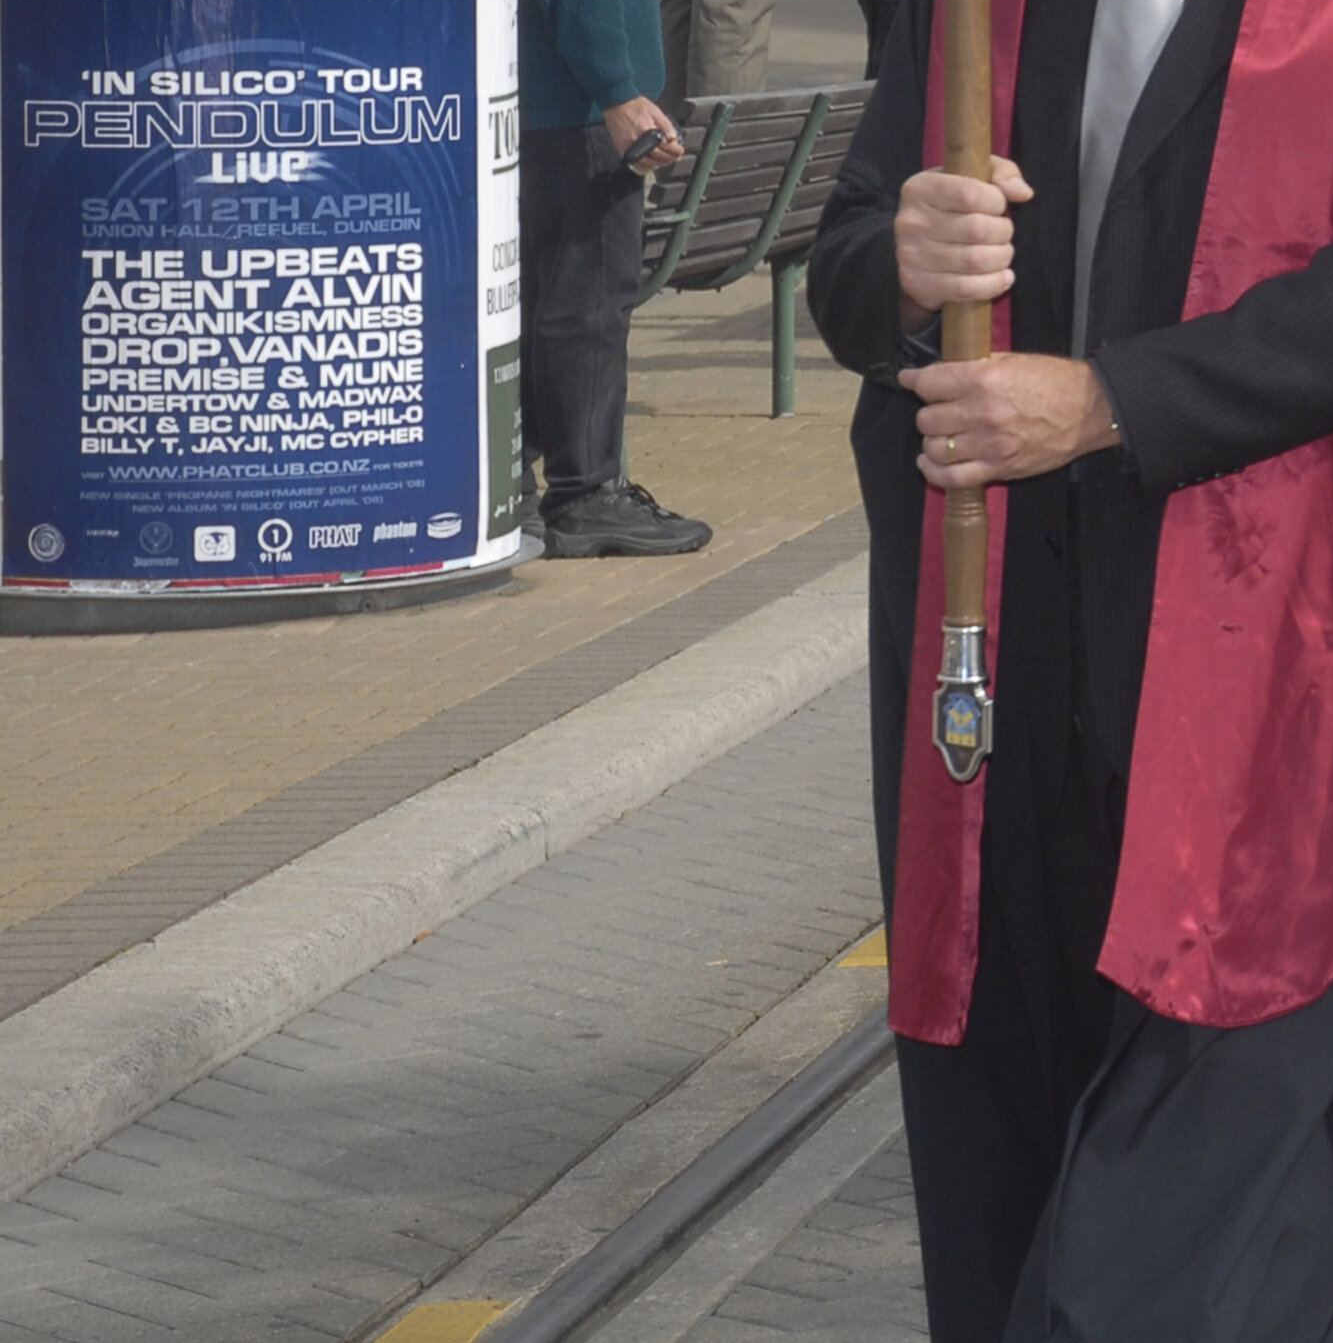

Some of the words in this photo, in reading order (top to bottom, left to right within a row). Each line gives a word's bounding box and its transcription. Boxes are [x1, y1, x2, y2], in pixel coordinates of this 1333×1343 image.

[317, 67, 423, 94] TOUR
[24, 94, 461, 148] PENDULUM
[81, 197, 168, 222] SAT
[182, 196, 299, 222] 12TH
[312, 192, 421, 220] APRIL
[82, 224, 154, 238] UNION
[334, 218, 421, 234] DUNEDIN
[82, 250, 184, 279] THE
[202, 243, 423, 279] UPBEATS
[82, 279, 271, 310] AGENT
[282, 272, 423, 308] ALVIN
[82, 304, 423, 335] ORGANIKISMNESS
[82, 367, 265, 391] PREMISE
[278, 366, 309, 389] &
[320, 358, 423, 388] MUNE
[82, 392, 260, 413] UNDERTOW
[267, 392, 290, 410] &
[299, 384, 423, 409] MADWAX
[81, 416, 147, 434] LOKI
[156, 416, 180, 434] &
[189, 415, 233, 434] BC
[240, 412, 335, 432] NINJA,
[81, 437, 155, 454] BILLY
[160, 437, 184, 456] T,
[191, 435, 274, 454] JAYJI,
[281, 433, 325, 452] MC
[330, 426, 423, 448] CYPHER
[108, 459, 370, 480] WWW.PHATCLUB.CO.NZ
[80, 492, 111, 500] NEW
[114, 491, 161, 500] SINGLE
[132, 504, 164, 513] NEW
[172, 503, 217, 513] ALBUM
[309, 524, 362, 549] PHAT
[373, 521, 417, 543] phantom
